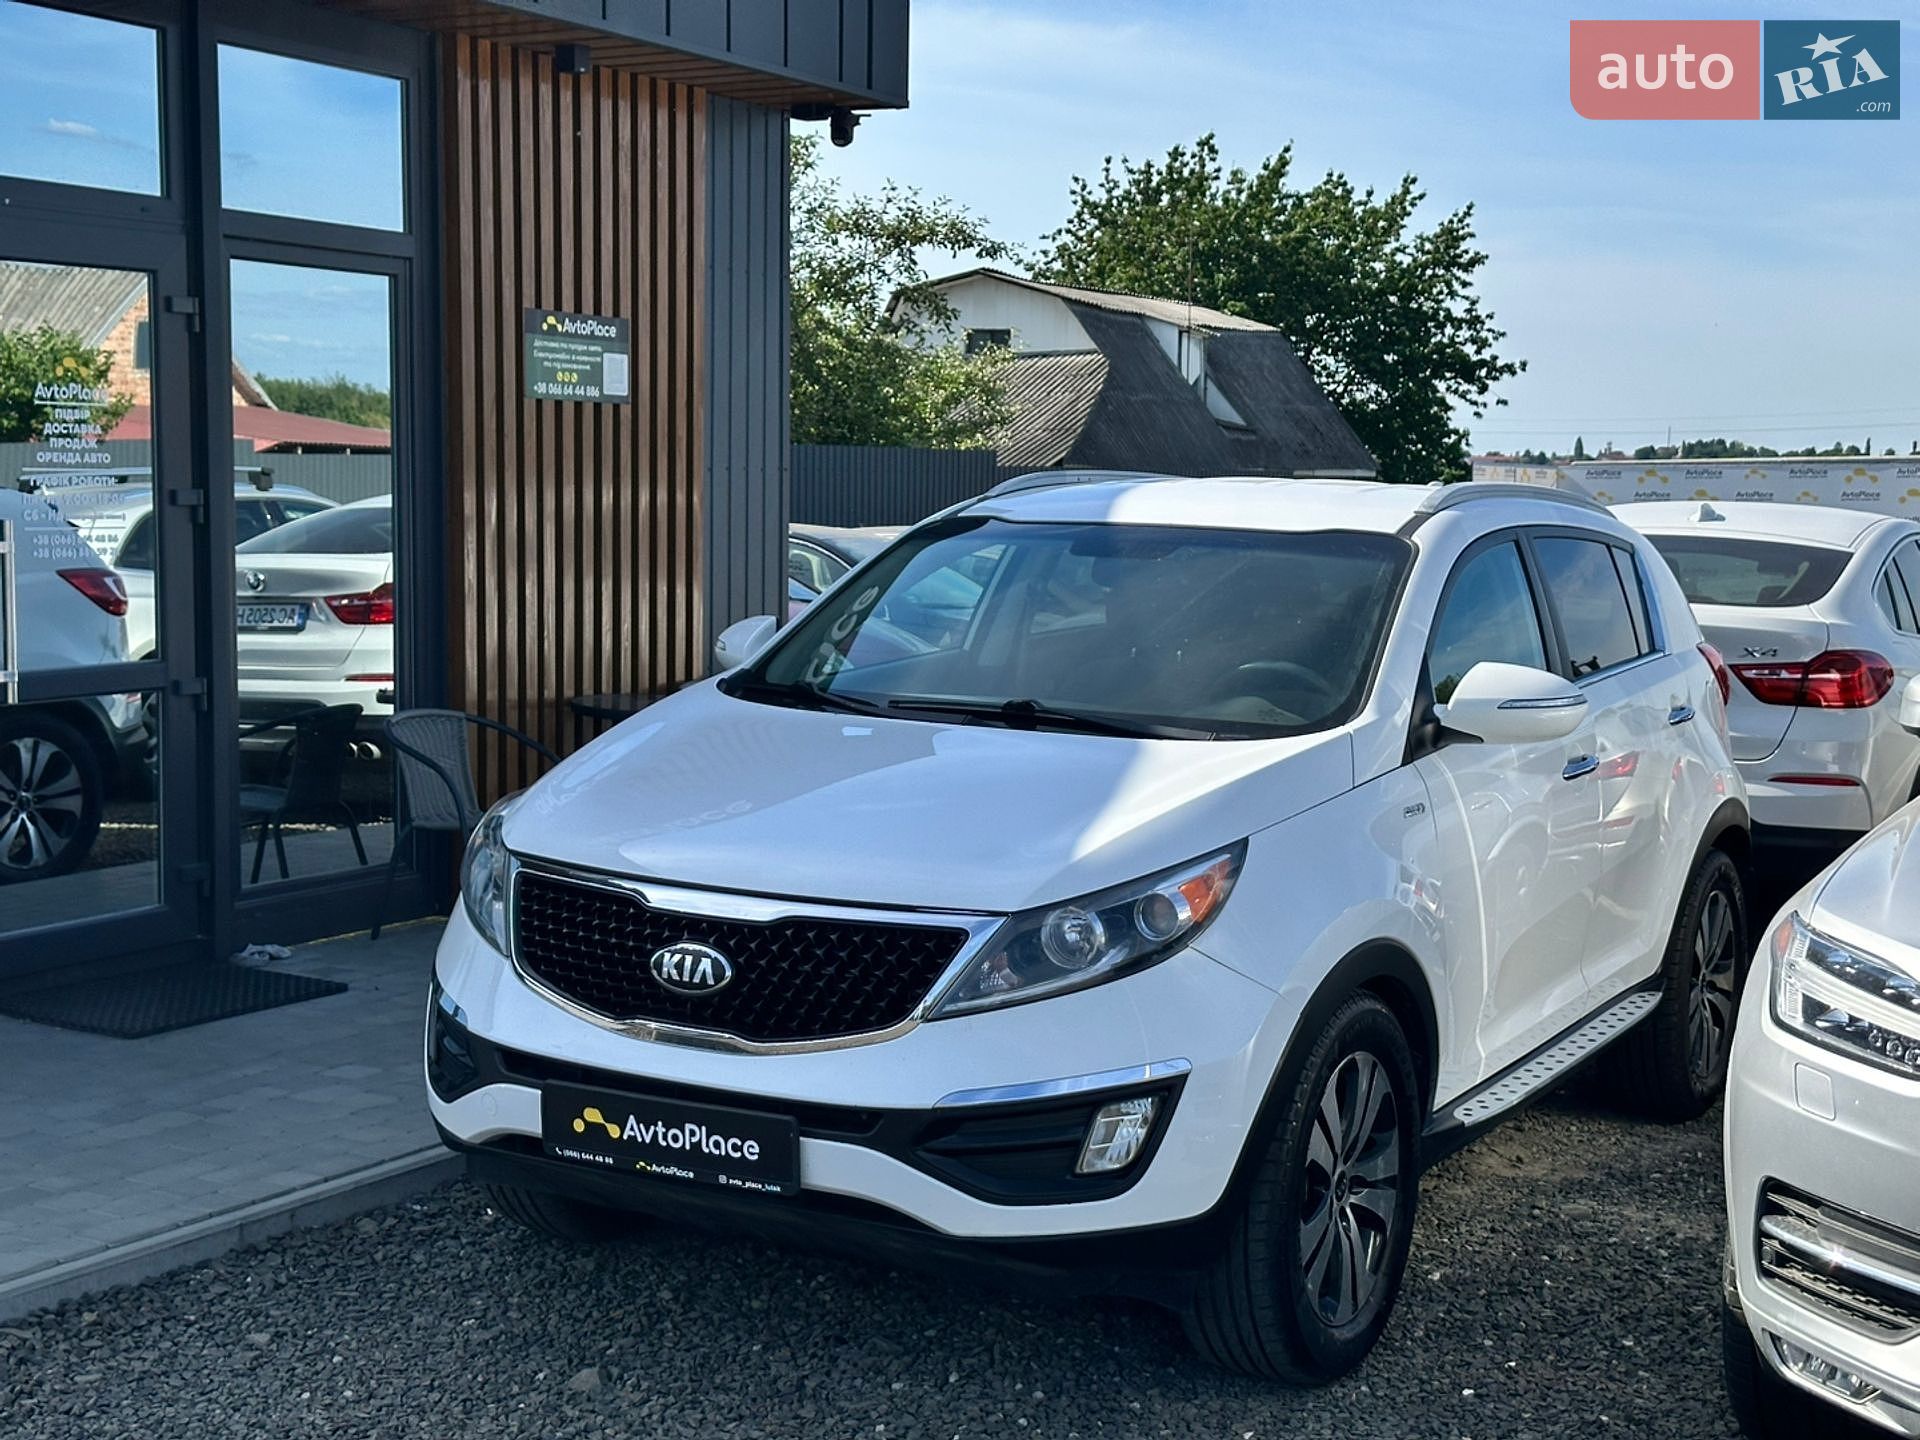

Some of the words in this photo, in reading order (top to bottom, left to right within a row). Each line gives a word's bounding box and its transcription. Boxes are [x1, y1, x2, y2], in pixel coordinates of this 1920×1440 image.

[563, 318, 616, 337] AvtoPlace
[35, 382, 108, 400] AvtoPlace
[534, 382, 546, 394] +38
[548, 383, 562, 395] 066
[563, 384, 573, 395] 64
[575, 385, 585, 396] 44
[43, 423, 101, 435] ДОСТАВКА
[50, 438, 97, 450] ПРОДАЖ
[37, 452, 80, 464] ОРЕНДА
[83, 453, 111, 463] АВТО
[33, 535, 49, 544] +38
[33, 548, 49, 558] +38
[1740, 646, 1778, 658] X4
[662, 953, 715, 985] KIA
[623, 1114, 760, 1161] AvtoPlace
[651, 1163, 695, 1180] AvtoPlace
